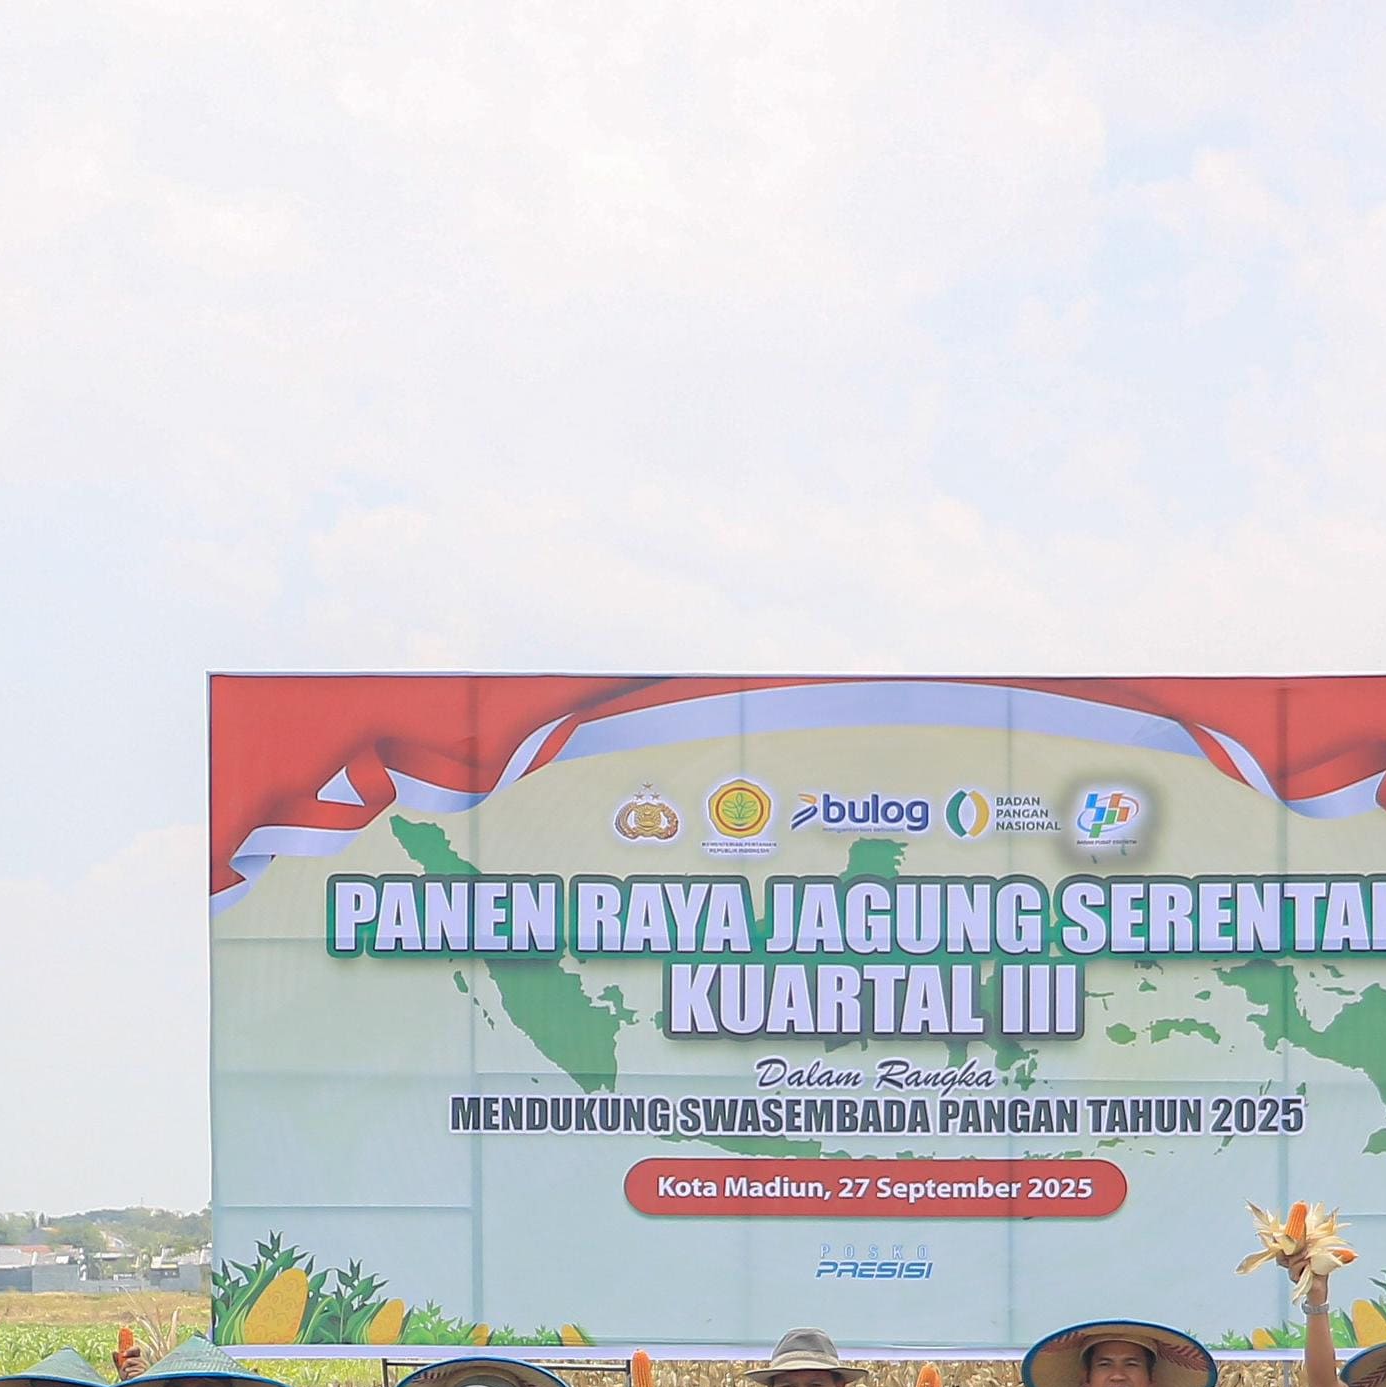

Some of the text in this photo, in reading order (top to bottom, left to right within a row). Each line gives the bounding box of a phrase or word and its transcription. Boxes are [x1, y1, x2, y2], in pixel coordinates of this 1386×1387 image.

[823, 793, 929, 831] bulog
[996, 797, 1040, 806] BADAN
[996, 809, 1048, 818] PANGAN
[996, 821, 1061, 831] NASIONAL
[334, 880, 557, 952] PANEN
[577, 880, 751, 952] RAYA
[765, 880, 1043, 954] JAGUNG
[669, 963, 1079, 1037] KUARTAL III
[756, 1059, 996, 1094] Dalam Rangka
[451, 1096, 1304, 1134] MENDUKUNG SWASEMBADA PANGAN TAHUN 2025
[658, 1175, 1093, 1201] Kota Madiun, 27 September 2025
[820, 1245, 928, 1259] POSKO
[816, 1261, 933, 1279] PRESISI
